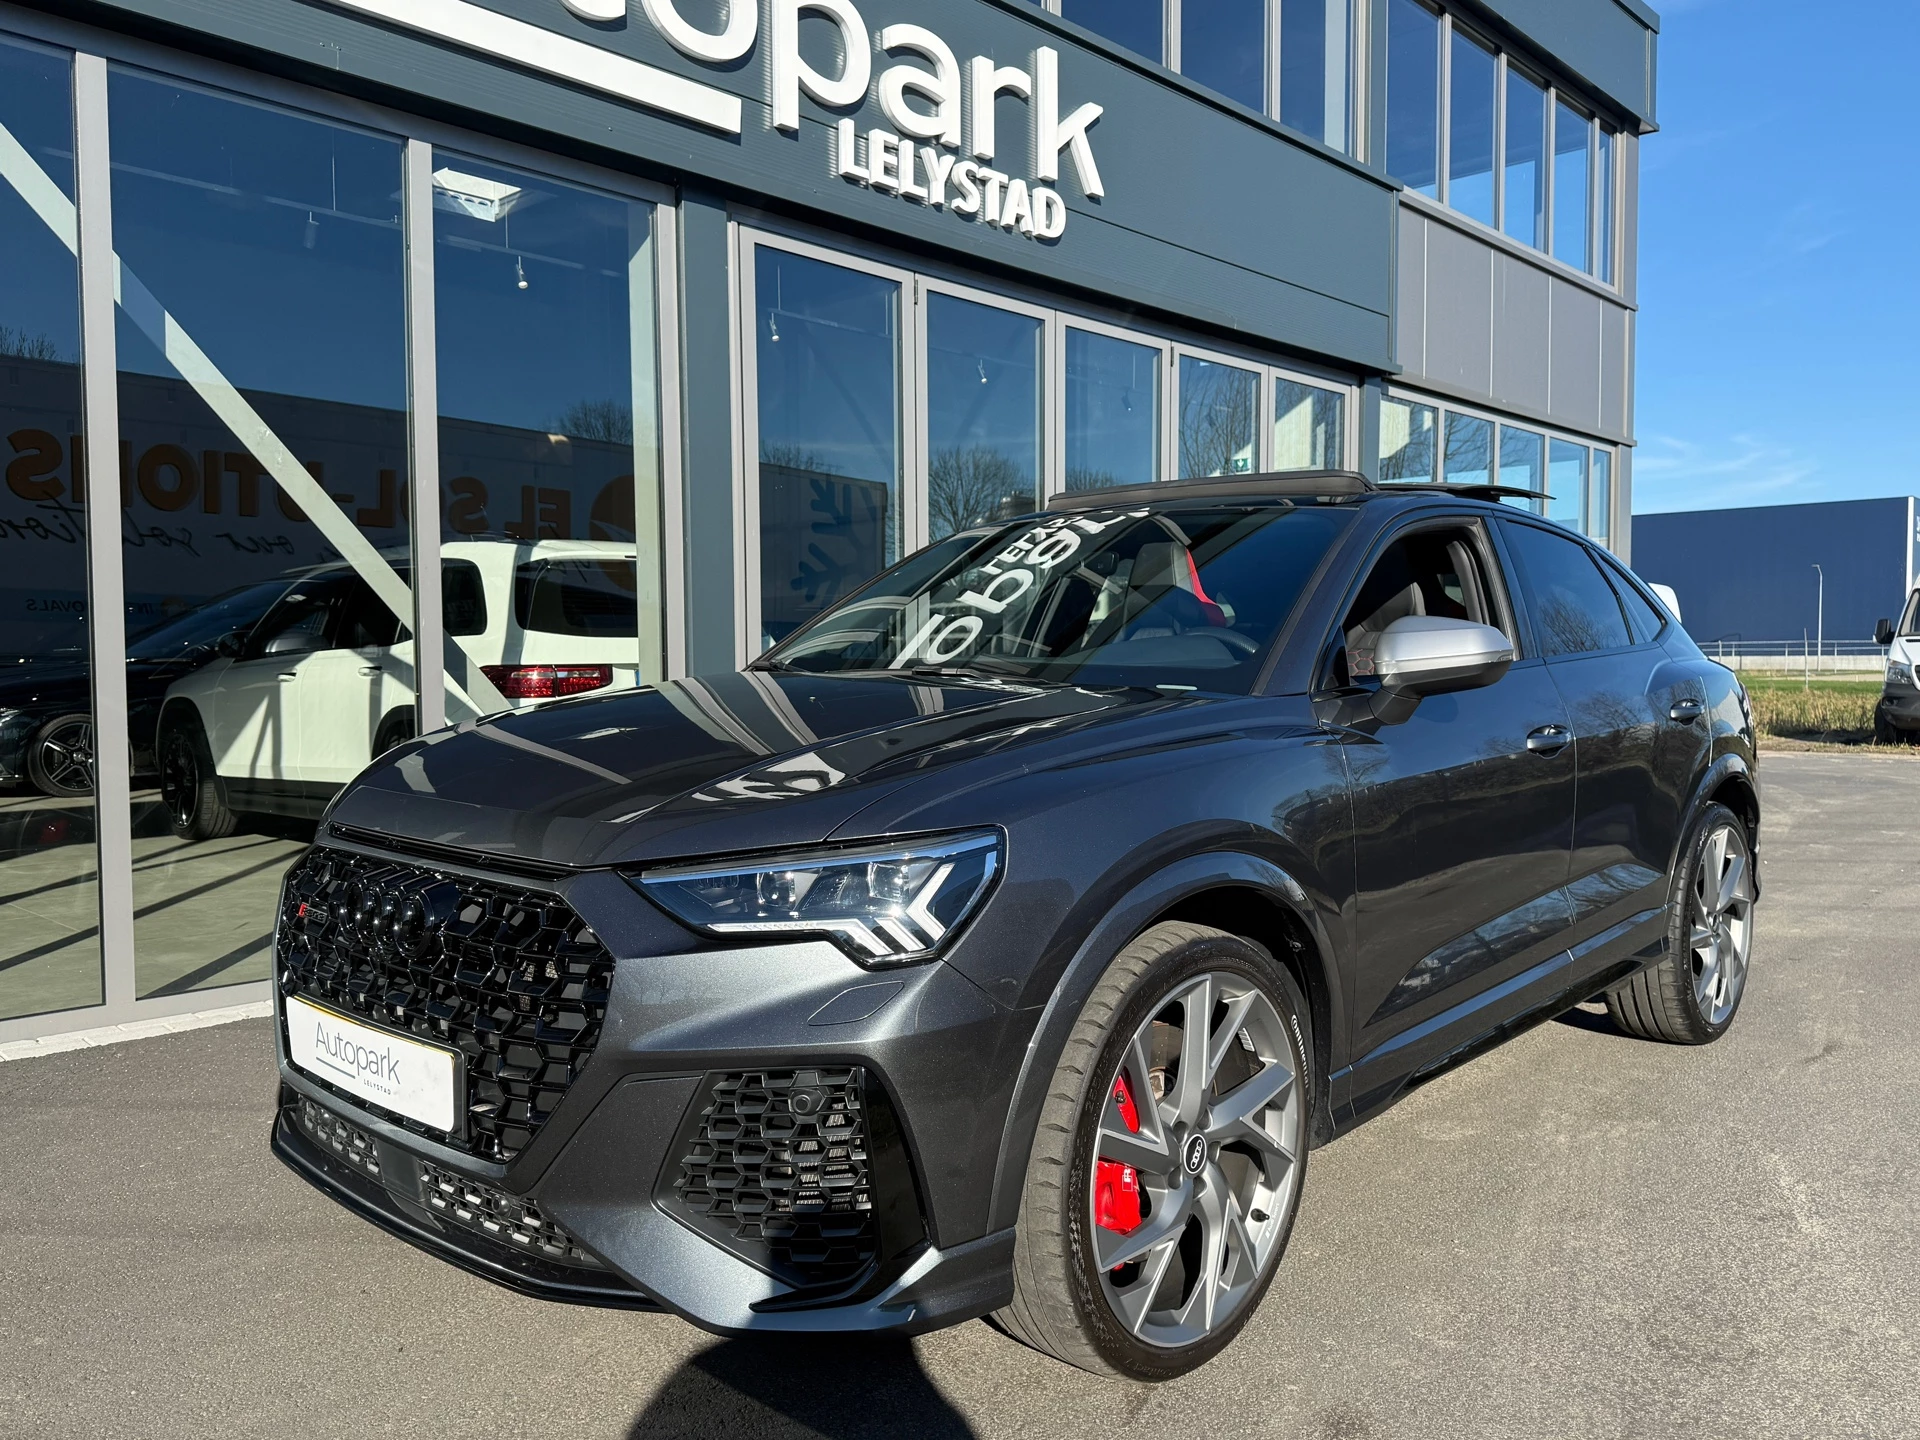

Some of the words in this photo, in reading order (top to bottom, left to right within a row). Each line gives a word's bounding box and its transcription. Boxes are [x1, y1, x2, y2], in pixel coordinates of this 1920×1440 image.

[558, 0, 1104, 198] opark
[837, 118, 1067, 241] LELYSTAD
[316, 1022, 400, 1084] Autopark
[363, 1078, 392, 1095] LELYSTAD
